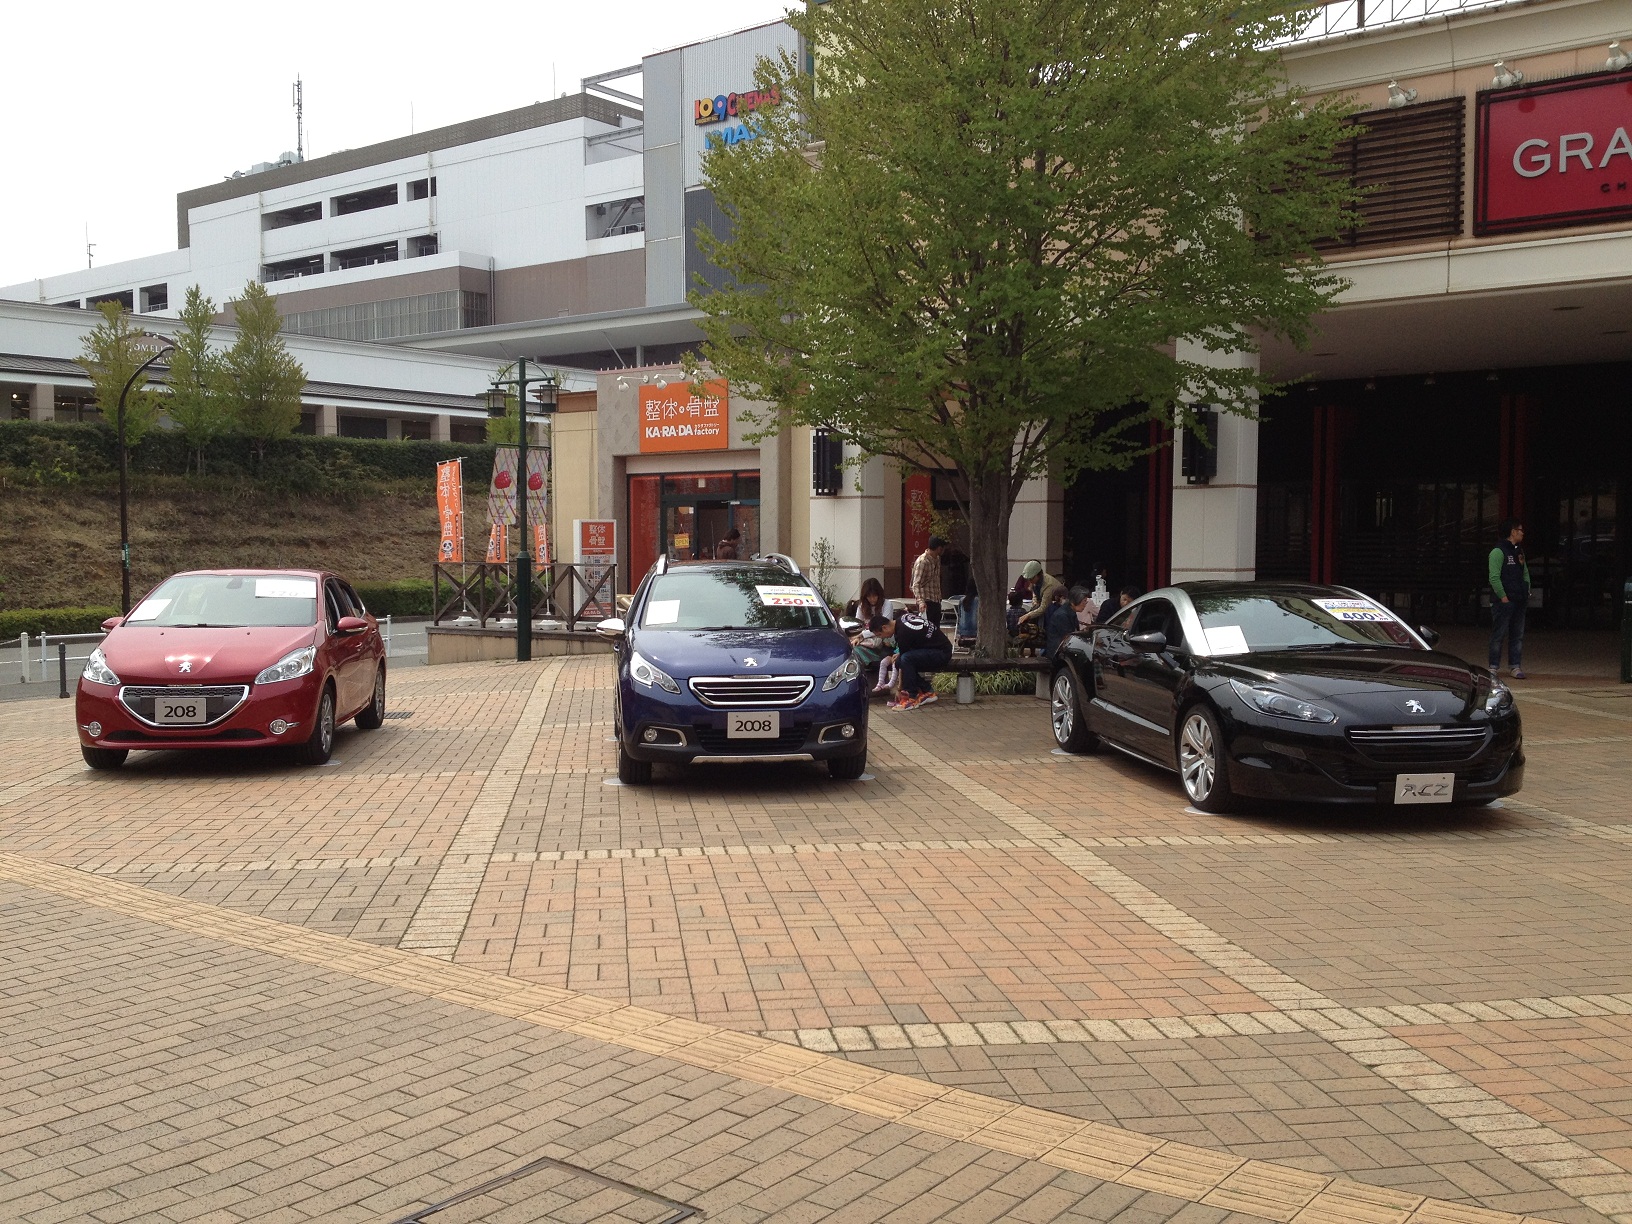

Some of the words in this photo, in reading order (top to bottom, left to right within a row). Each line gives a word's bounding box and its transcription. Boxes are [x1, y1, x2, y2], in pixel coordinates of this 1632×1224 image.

[695, 94, 728, 121] 109
[694, 427, 720, 436] factory
[163, 705, 197, 718] 208
[735, 720, 772, 732] 2008
[1400, 783, 1449, 797] RCZ
